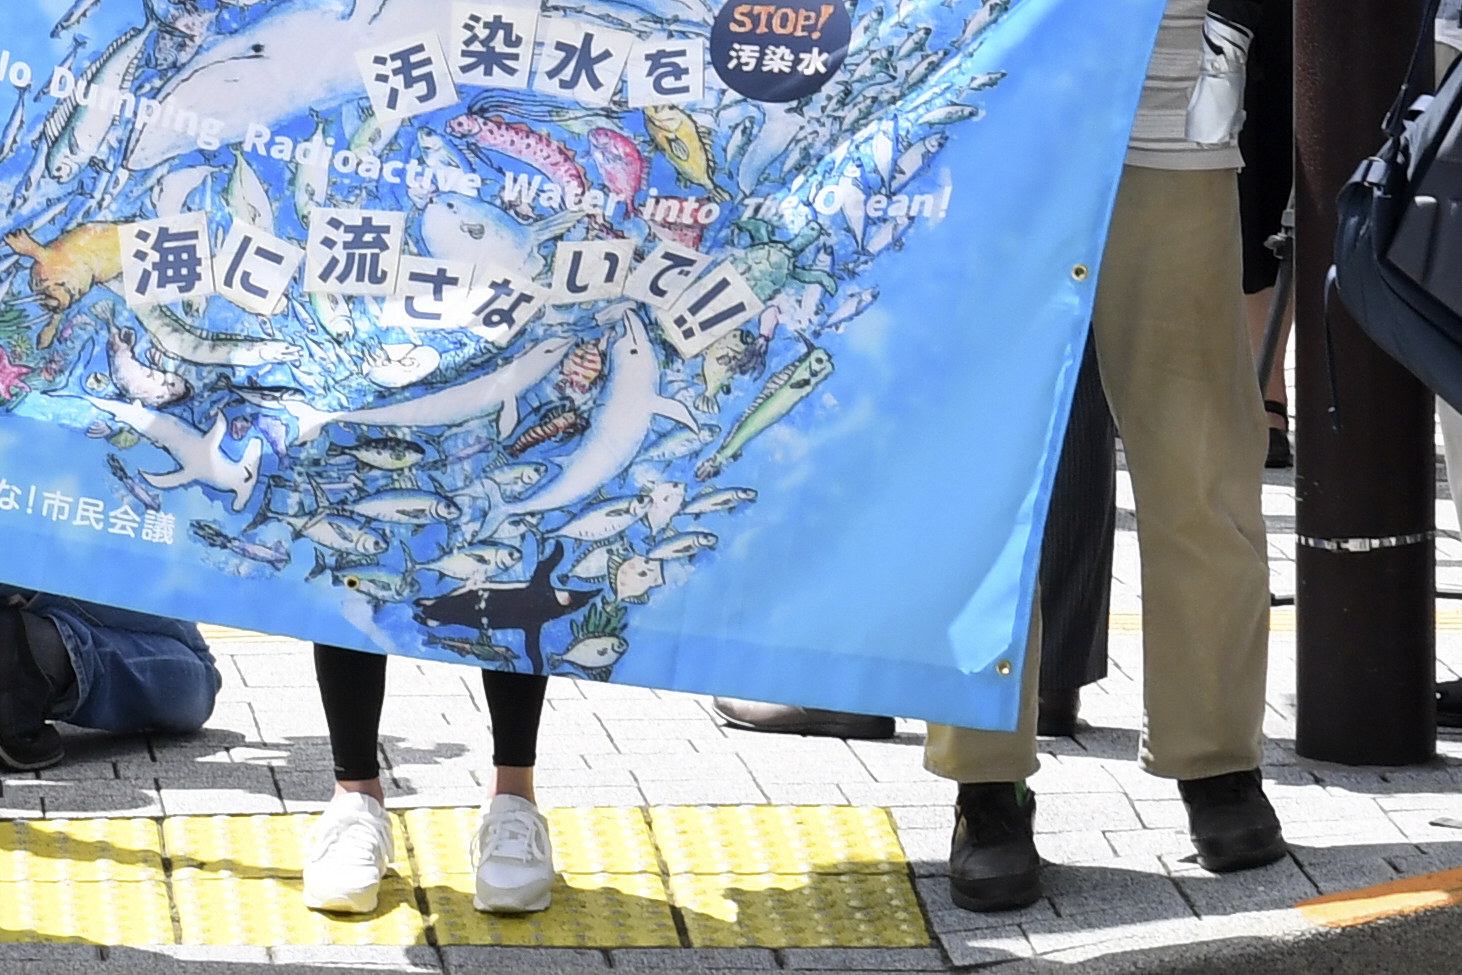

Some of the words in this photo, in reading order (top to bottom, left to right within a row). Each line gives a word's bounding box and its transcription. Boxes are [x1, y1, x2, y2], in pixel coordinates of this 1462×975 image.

[728, 4, 835, 42] STOP!
[372, 13, 692, 111] 汚染水を
[727, 42, 829, 75] 汚染水
[49, 65, 224, 150] Dumping
[243, 122, 482, 196] Radioactive
[503, 168, 624, 217] Water
[640, 188, 722, 226] into
[812, 168, 953, 219] Oean!
